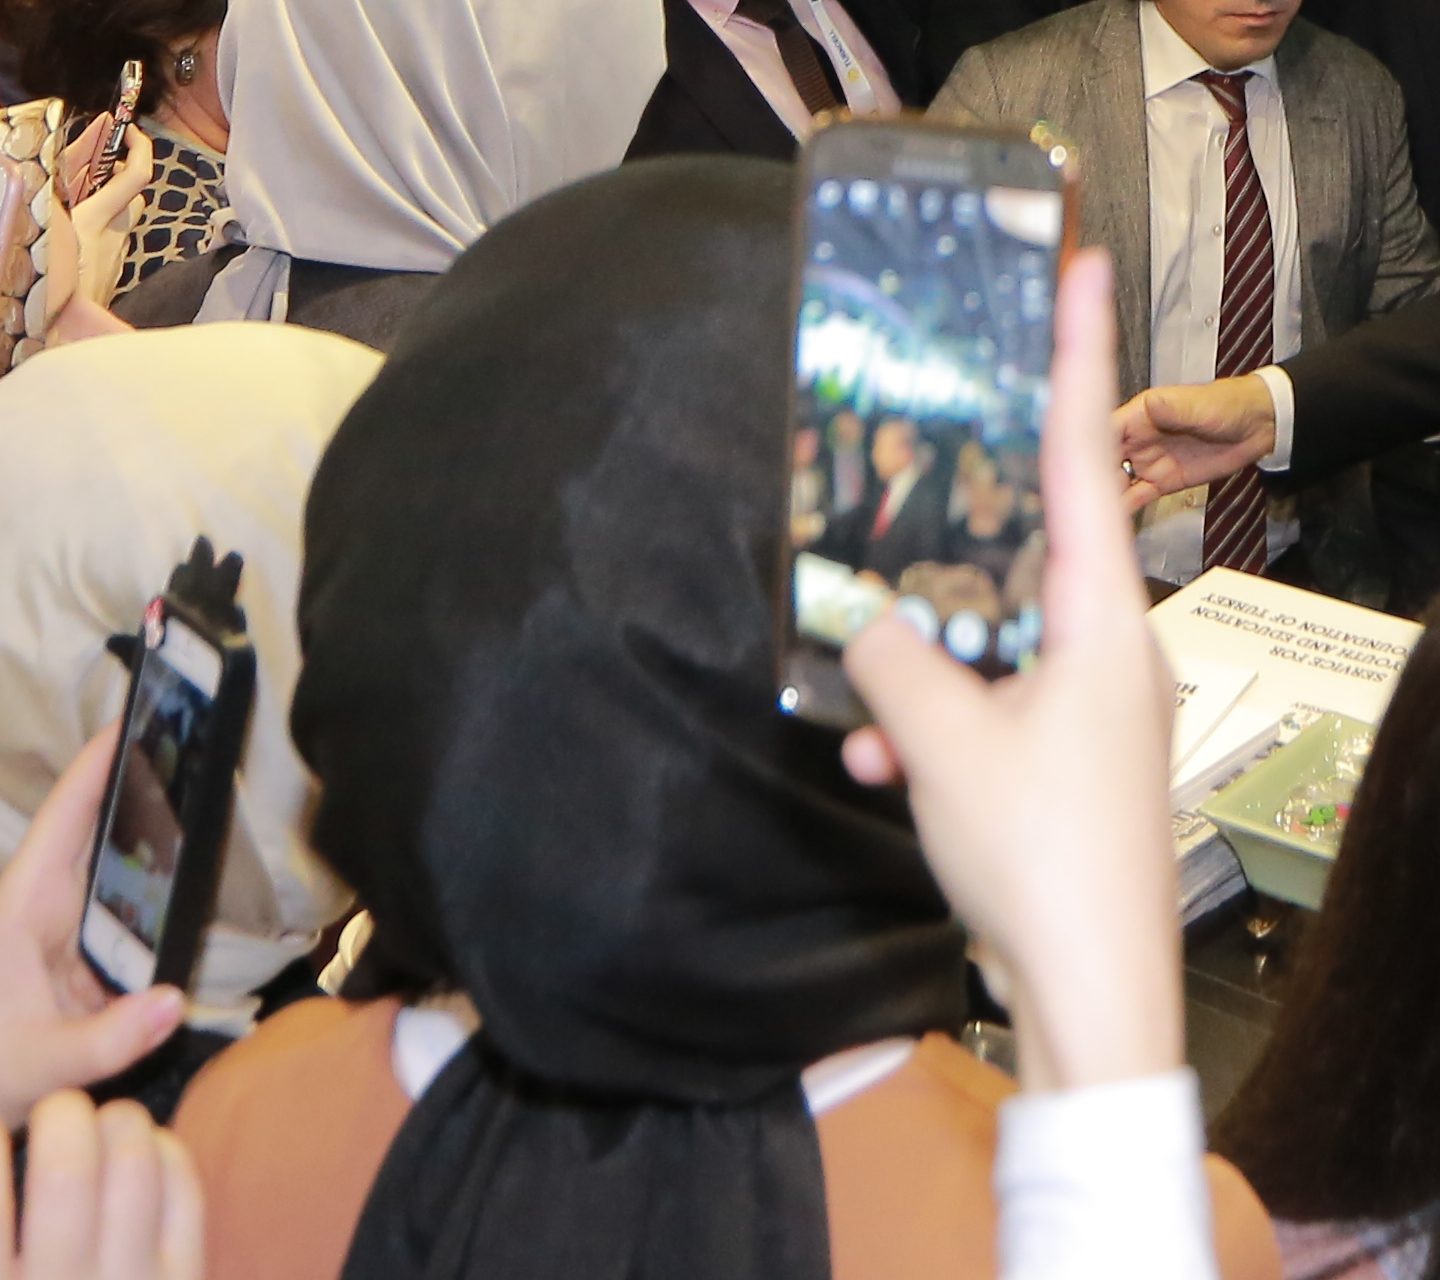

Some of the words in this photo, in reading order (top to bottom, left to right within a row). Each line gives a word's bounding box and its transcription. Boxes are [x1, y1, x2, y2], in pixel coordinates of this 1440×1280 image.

[1200, 592, 1267, 619] TURKEY
[1189, 605, 1295, 644] EDUCATION
[1271, 613, 1297, 627] OF
[1296, 634, 1332, 654] AND
[1300, 620, 1412, 659] OUNDATION
[1268, 645, 1309, 662] FOR
[1310, 656, 1388, 684] SERVICE
